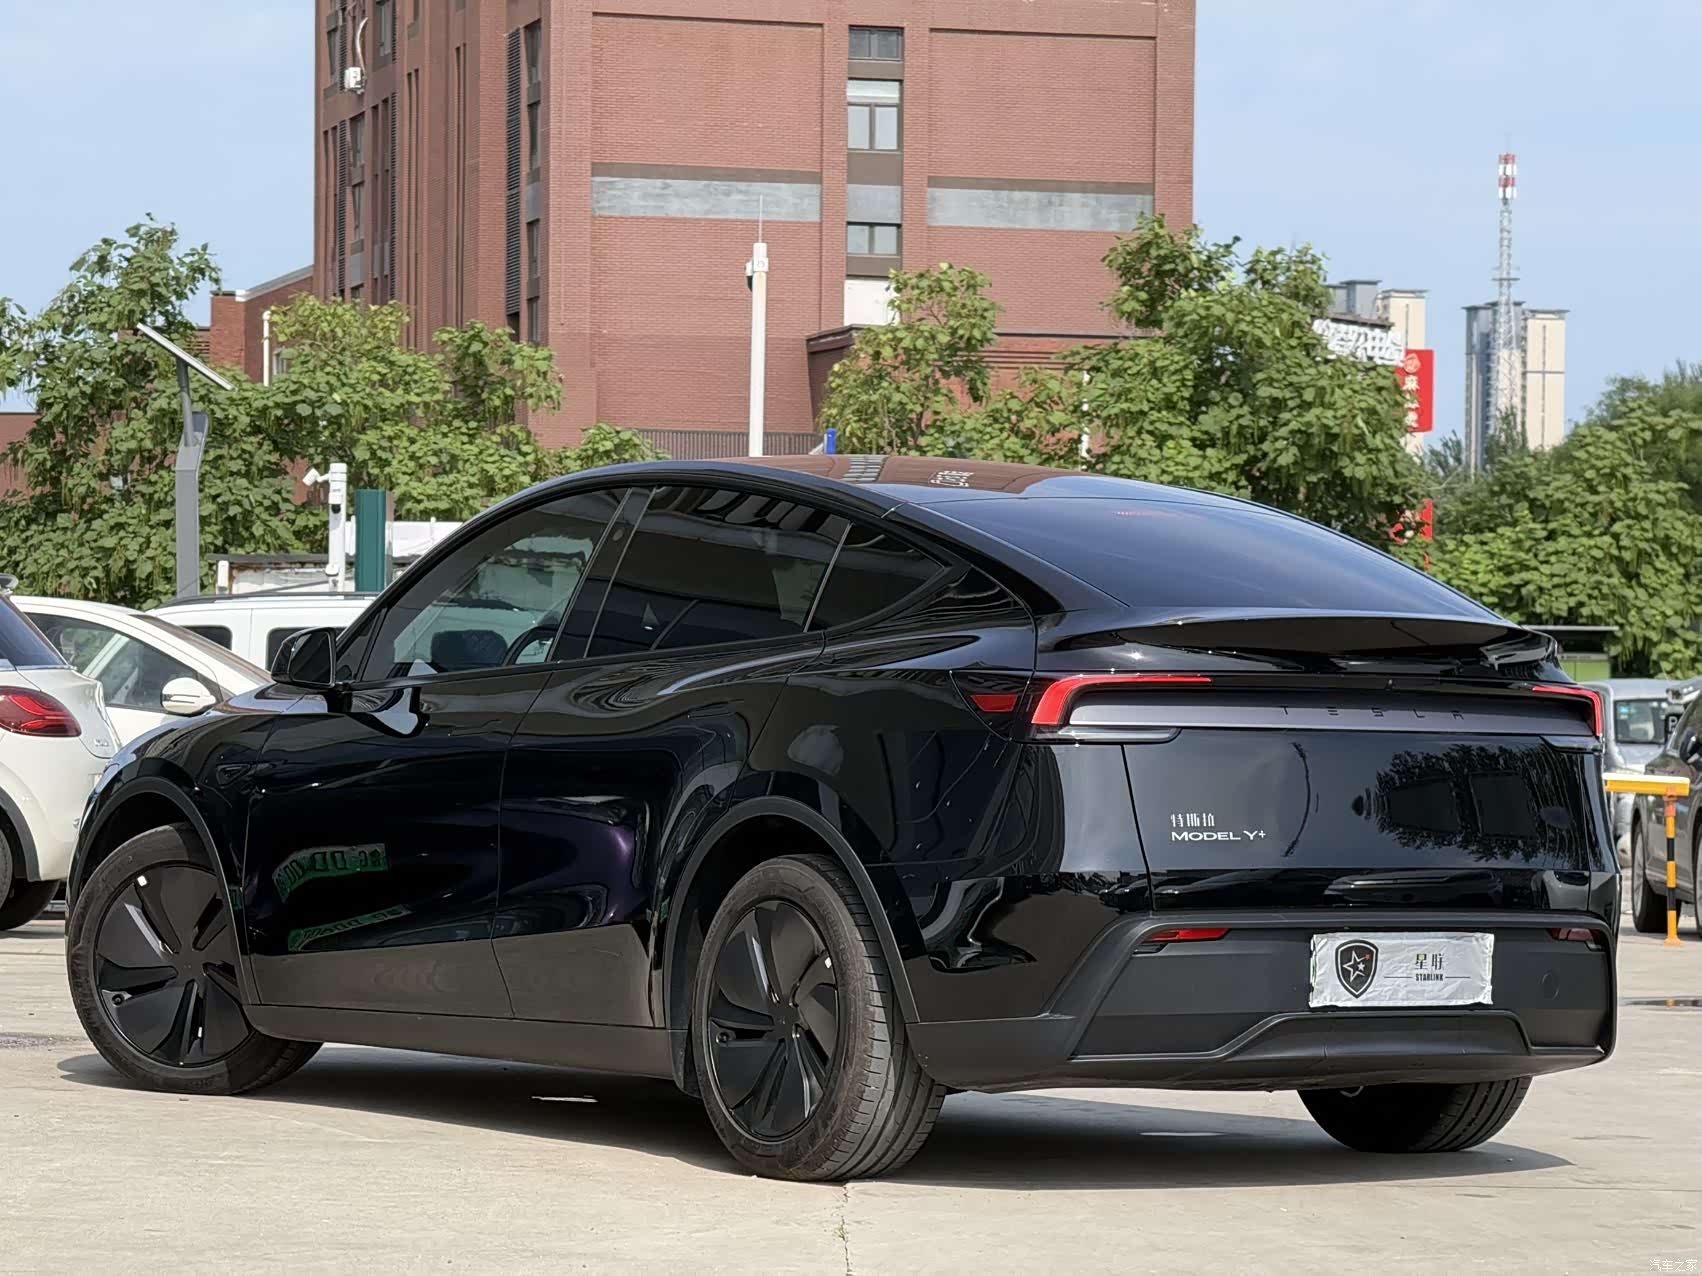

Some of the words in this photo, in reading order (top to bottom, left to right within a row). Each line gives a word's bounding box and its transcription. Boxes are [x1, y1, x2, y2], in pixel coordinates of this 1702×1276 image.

[1279, 705, 1465, 720] TESLA
[1170, 812, 1215, 828] 特斯拉
[1171, 831, 1241, 842] MODEL
[1243, 829, 1267, 841] Y+
